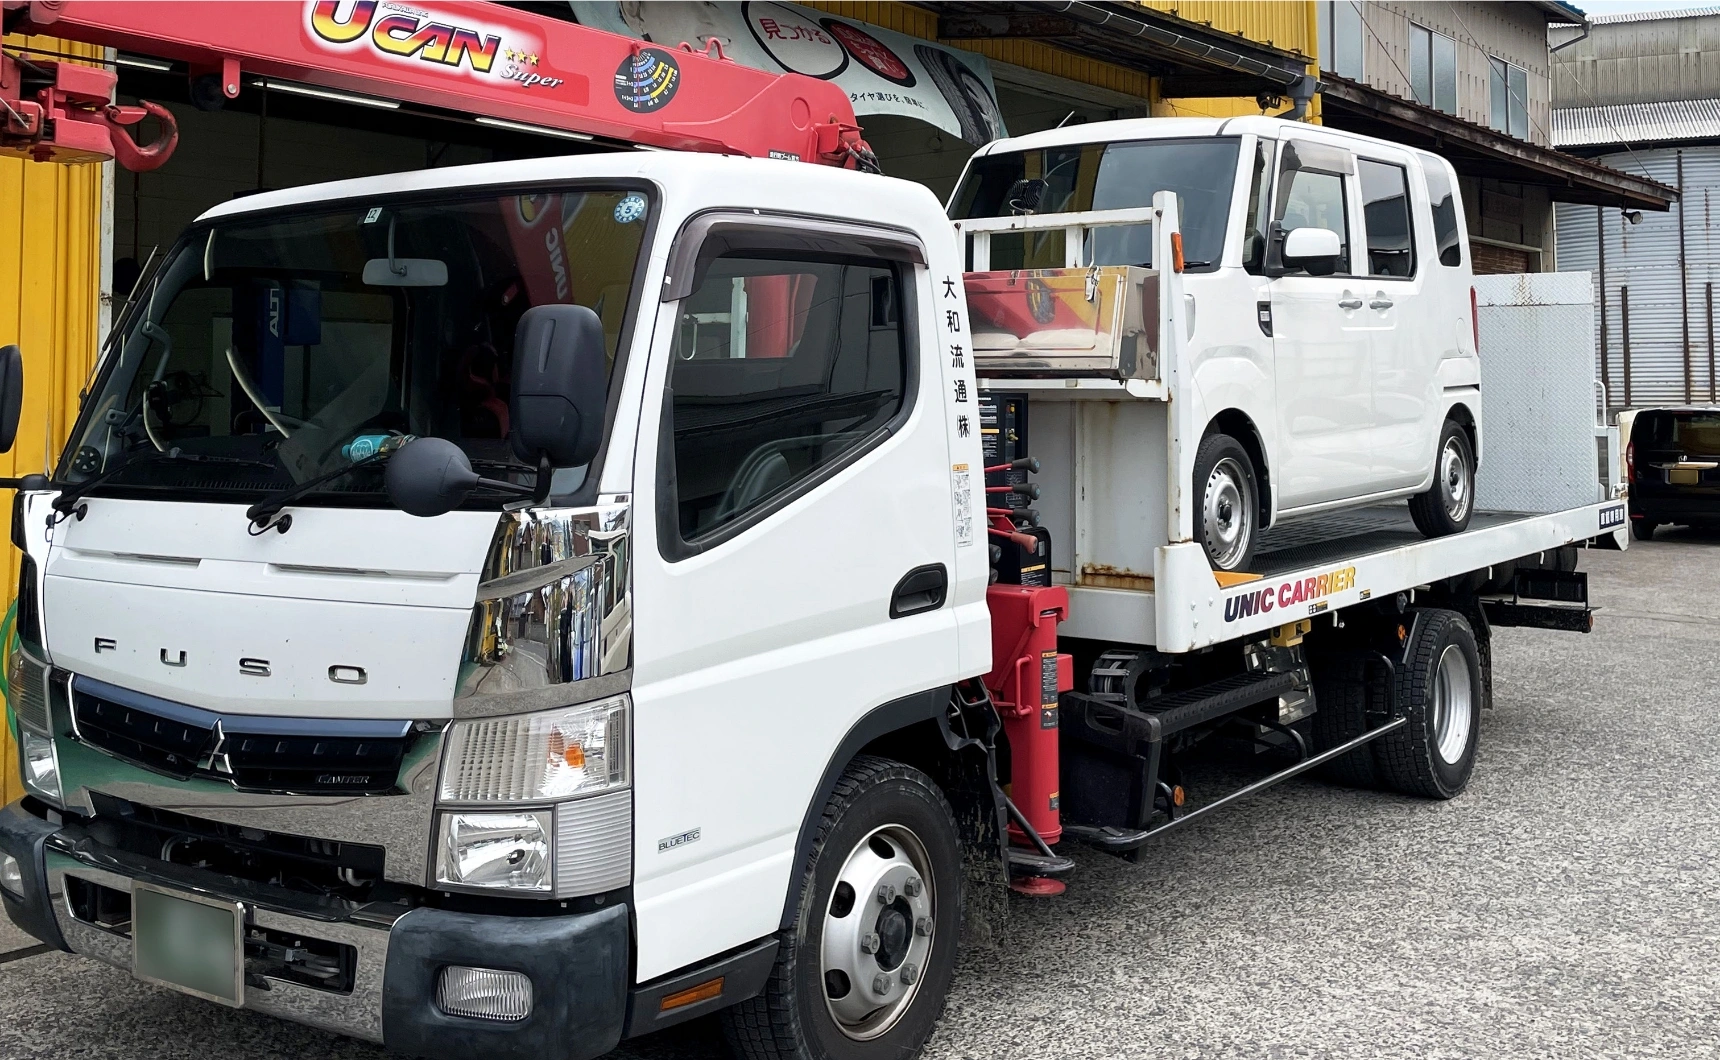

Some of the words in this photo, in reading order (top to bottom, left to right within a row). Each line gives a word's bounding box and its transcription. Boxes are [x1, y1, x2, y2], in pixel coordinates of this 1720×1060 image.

[311, 0, 501, 73] UCAN
[759, 18, 831, 45] 見つかる
[500, 63, 563, 89] Super
[1224, 587, 1275, 623] UNIC
[1277, 566, 1356, 608] CARRIER
[94, 636, 368, 685] FUSO
[658, 829, 700, 851] BLUETEC
